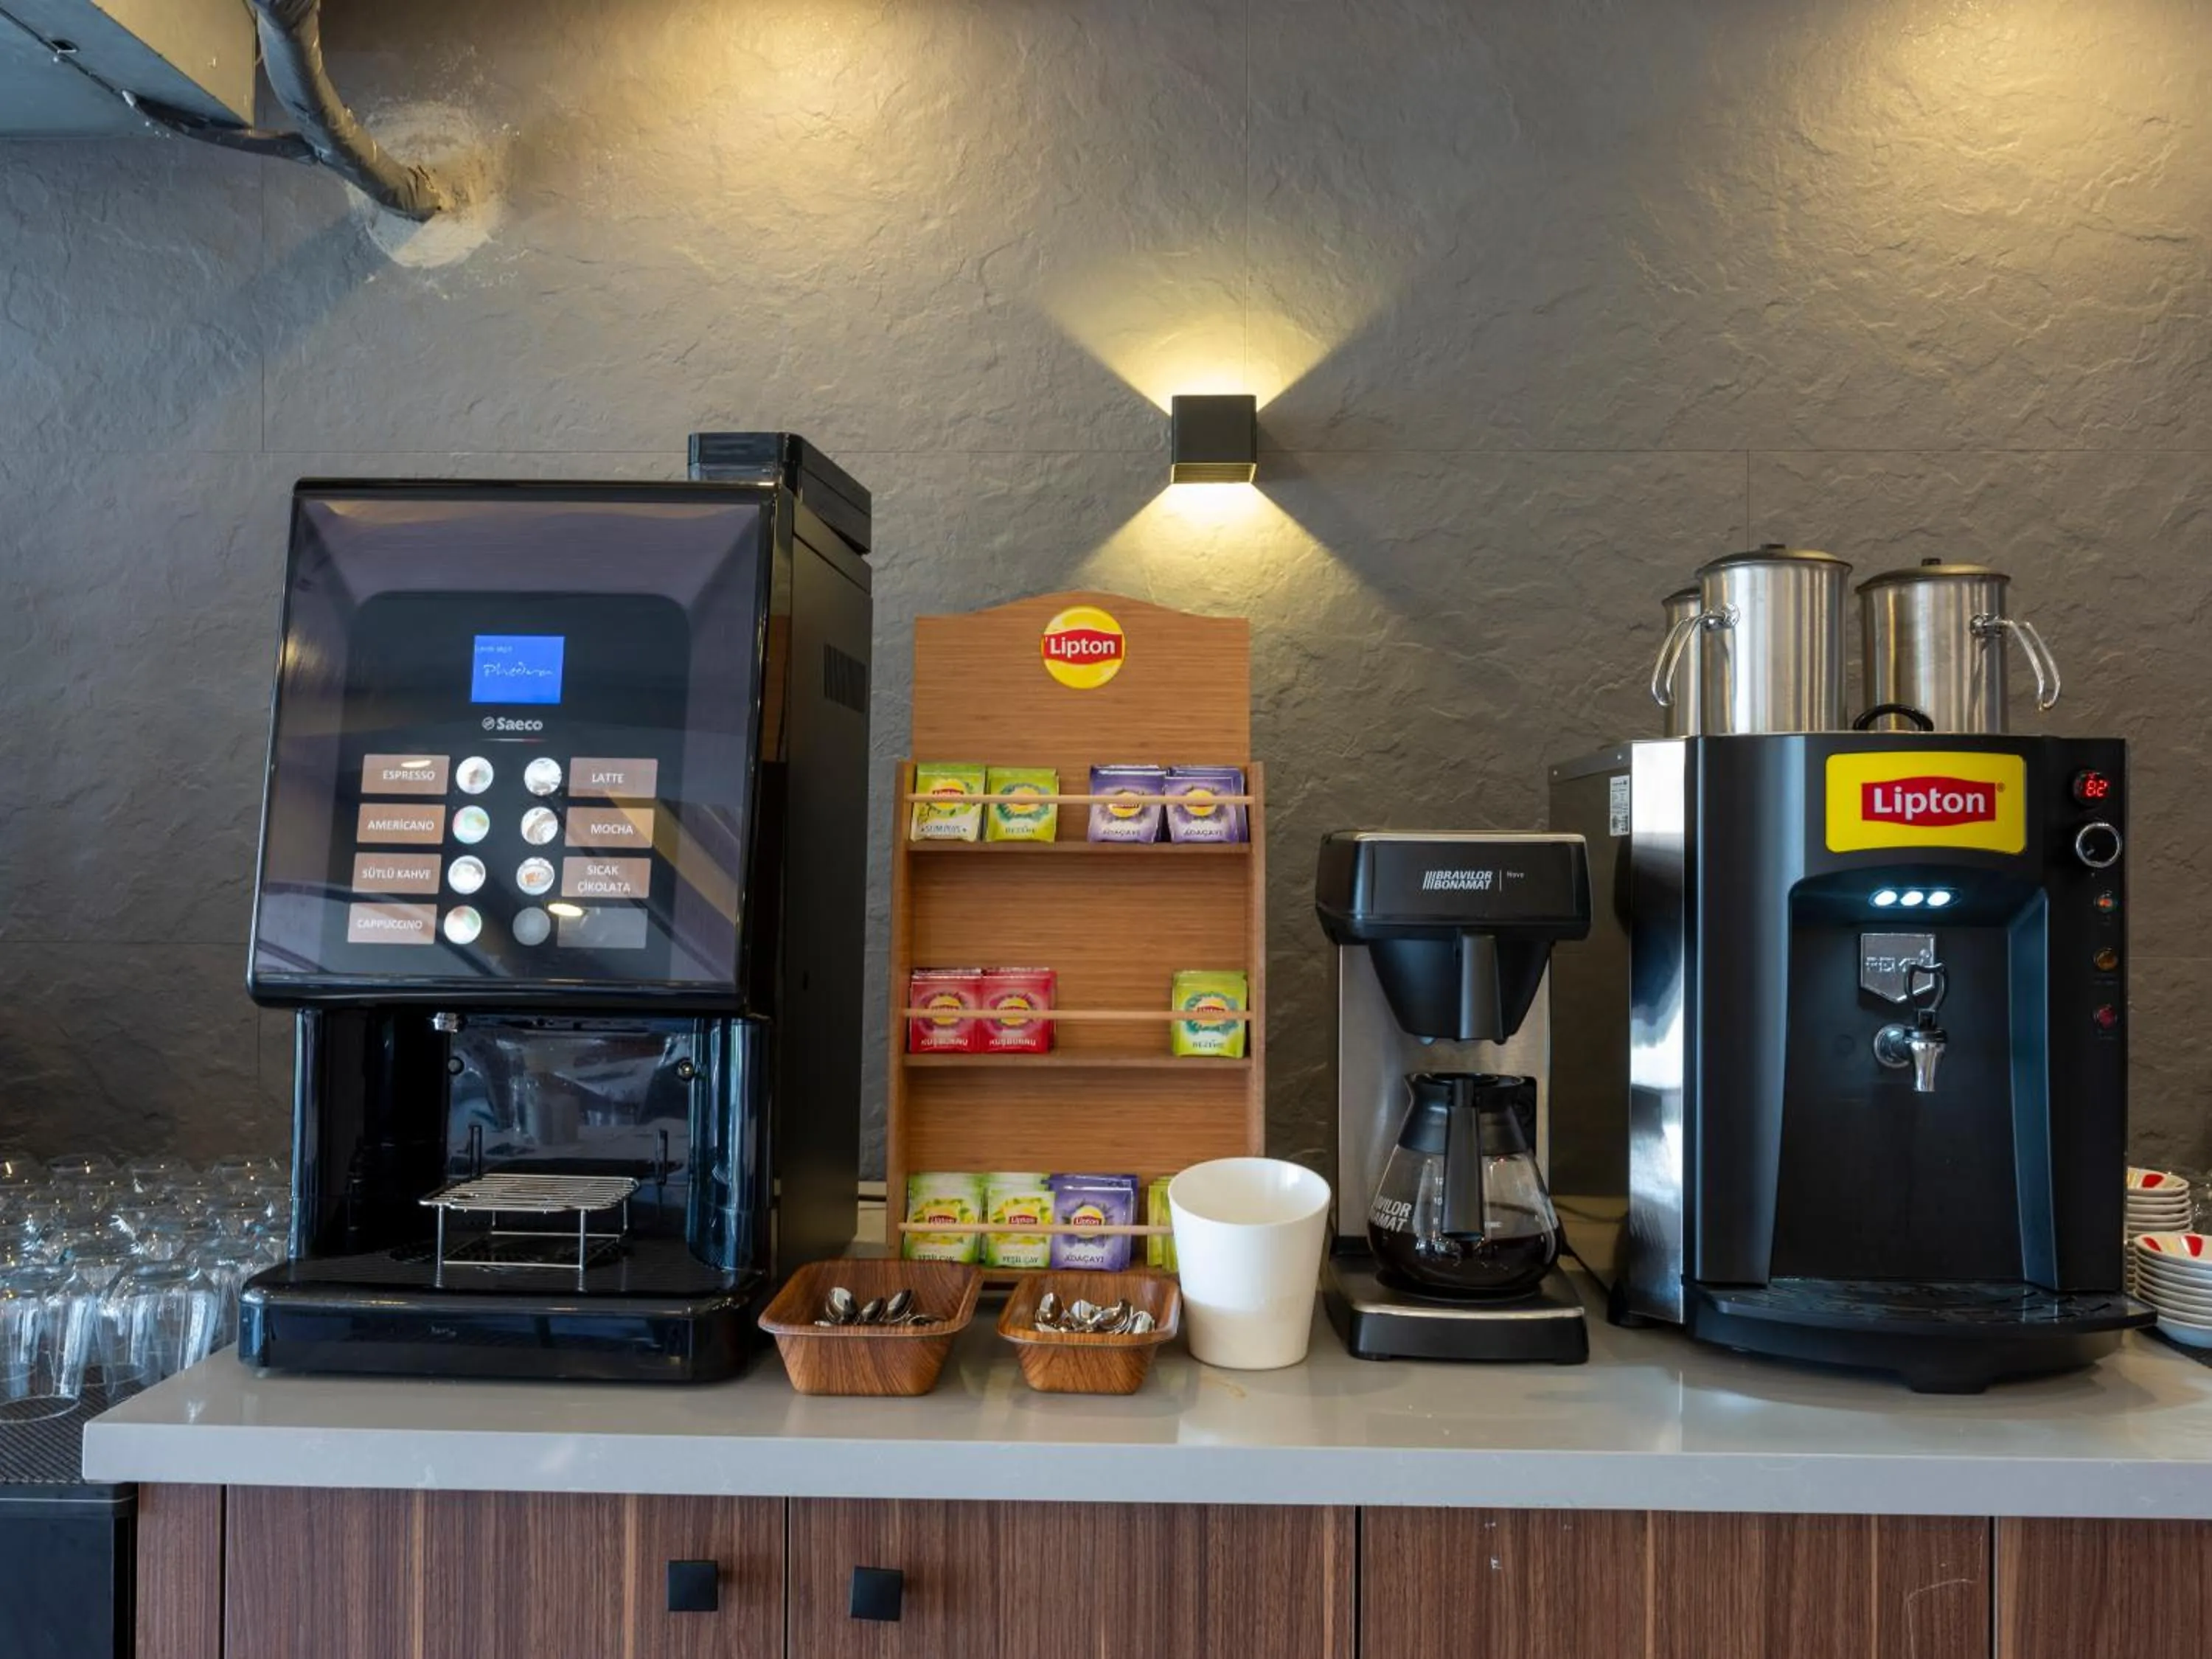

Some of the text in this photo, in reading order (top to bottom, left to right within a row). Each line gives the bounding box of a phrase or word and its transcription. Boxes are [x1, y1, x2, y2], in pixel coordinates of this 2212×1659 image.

[1049, 637, 1116, 658] Lipton
[496, 717, 543, 731] Saeco
[383, 770, 435, 781] ESPRESSO
[591, 773, 625, 784] LATTE
[2086, 779, 2107, 796] 82
[1874, 786, 1986, 820] Lipton
[591, 824, 633, 835] MOCHA
[362, 867, 431, 880] SÜTLÜ KAHVE
[587, 865, 619, 876] SICAK
[1436, 870, 1492, 880] BRAVILOR
[1434, 880, 1491, 890] BONAMAT
[357, 919, 422, 931] CAPPUCCINO
[1010, 1216, 1037, 1225] Lipton
[1074, 1217, 1100, 1226] Lipton
[1064, 1254, 1105, 1264] ADAÇAYI
